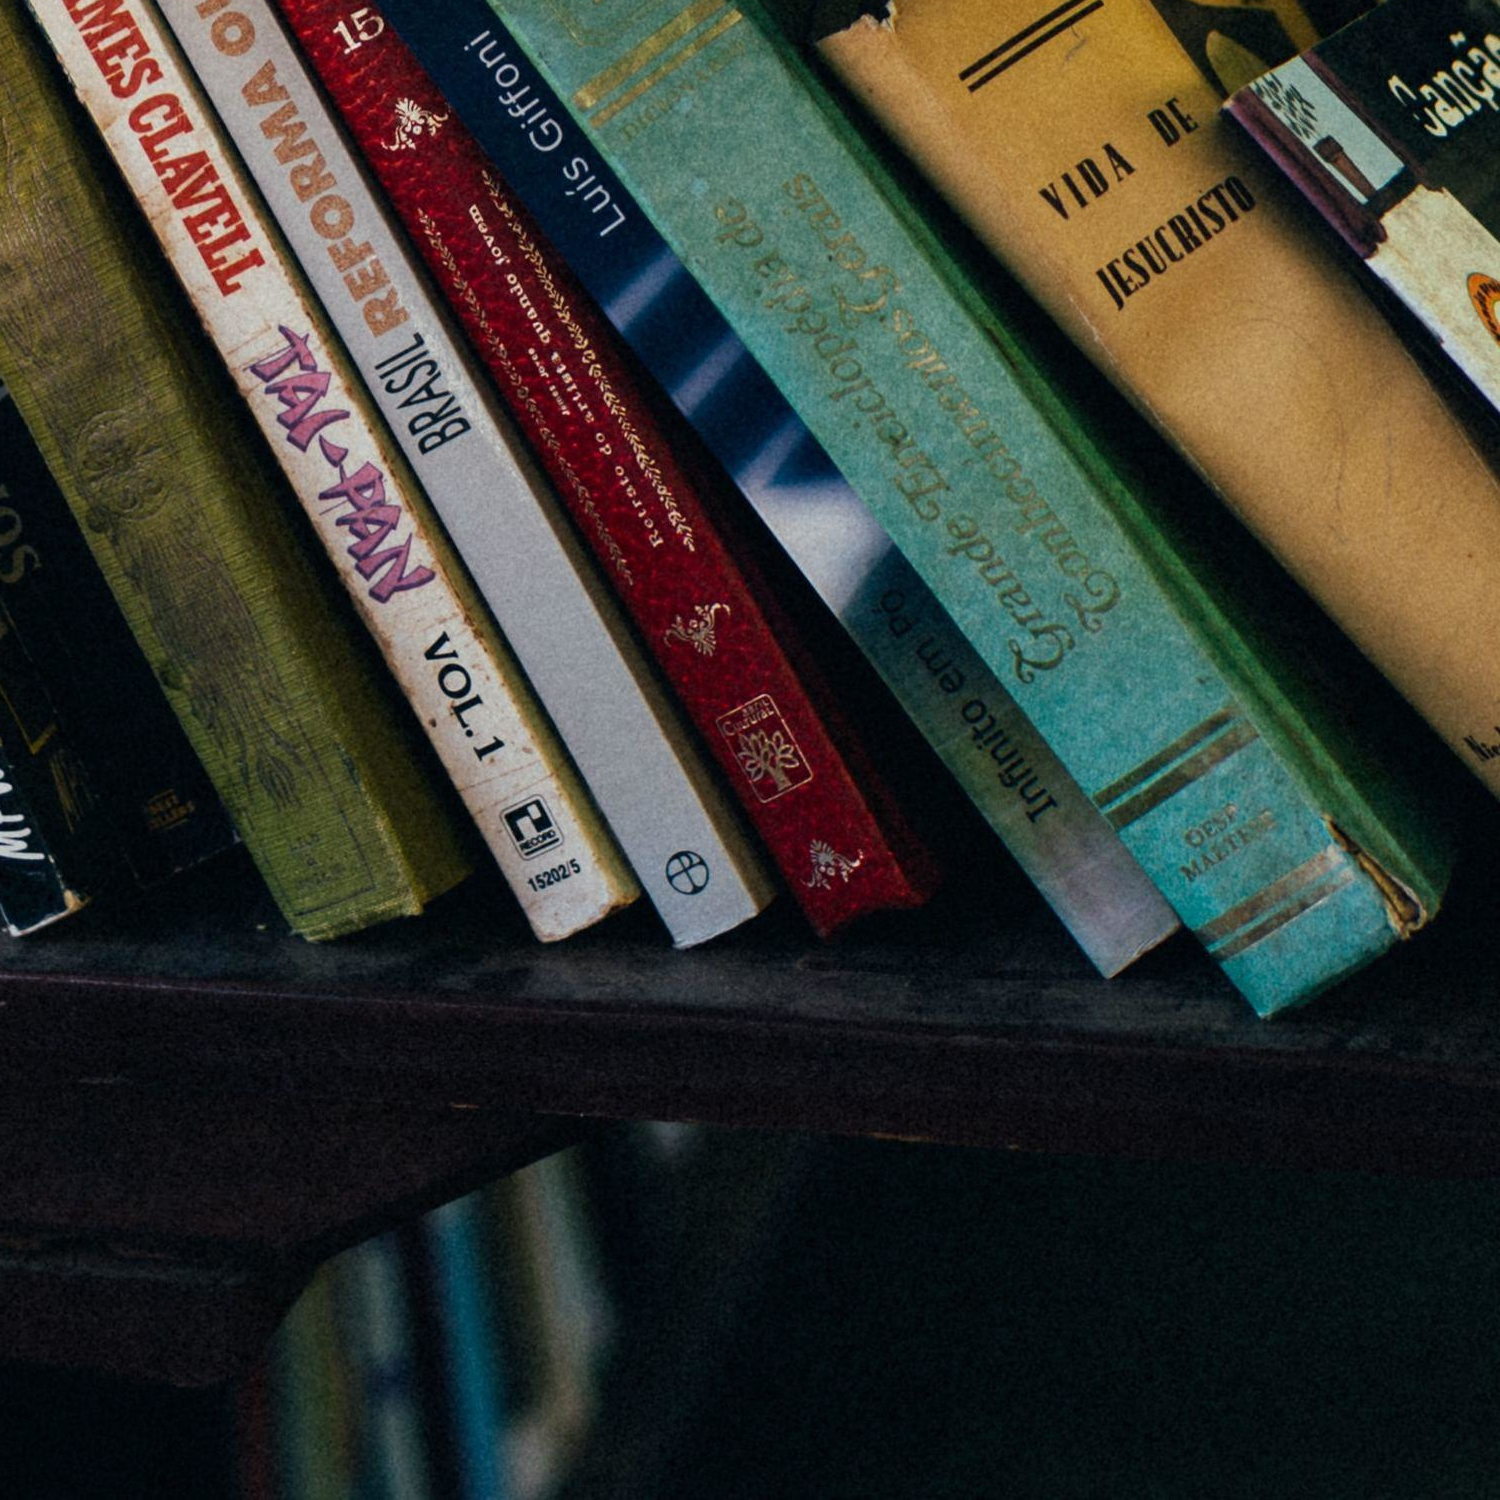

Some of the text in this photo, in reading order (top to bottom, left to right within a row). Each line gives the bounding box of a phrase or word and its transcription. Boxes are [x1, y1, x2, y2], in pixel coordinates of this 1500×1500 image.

[332, 8, 386, 55] 15
[462, 29, 626, 238] Luís Giffoni
[129, 92, 265, 298] CLAVELL
[241, 59, 407, 338] REFORMA
[1040, 98, 1199, 222] VIDA DE
[1096, 175, 1257, 311] JESUCRISTO
[244, 324, 435, 604] TAI-PAN
[375, 333, 471, 455] BRASIL
[468, 204, 666, 548] Retrato do artista quando jovem
[713, 195, 1077, 686] Grande Enciclopédia de
[782, 172, 1121, 635] Conhecimentos Gerais
[424, 631, 505, 762] VOL. 1
[880, 587, 1057, 824] Infinito em Pó
[520, 830, 557, 852] RECORD
[527, 859, 582, 893] 15202/5
